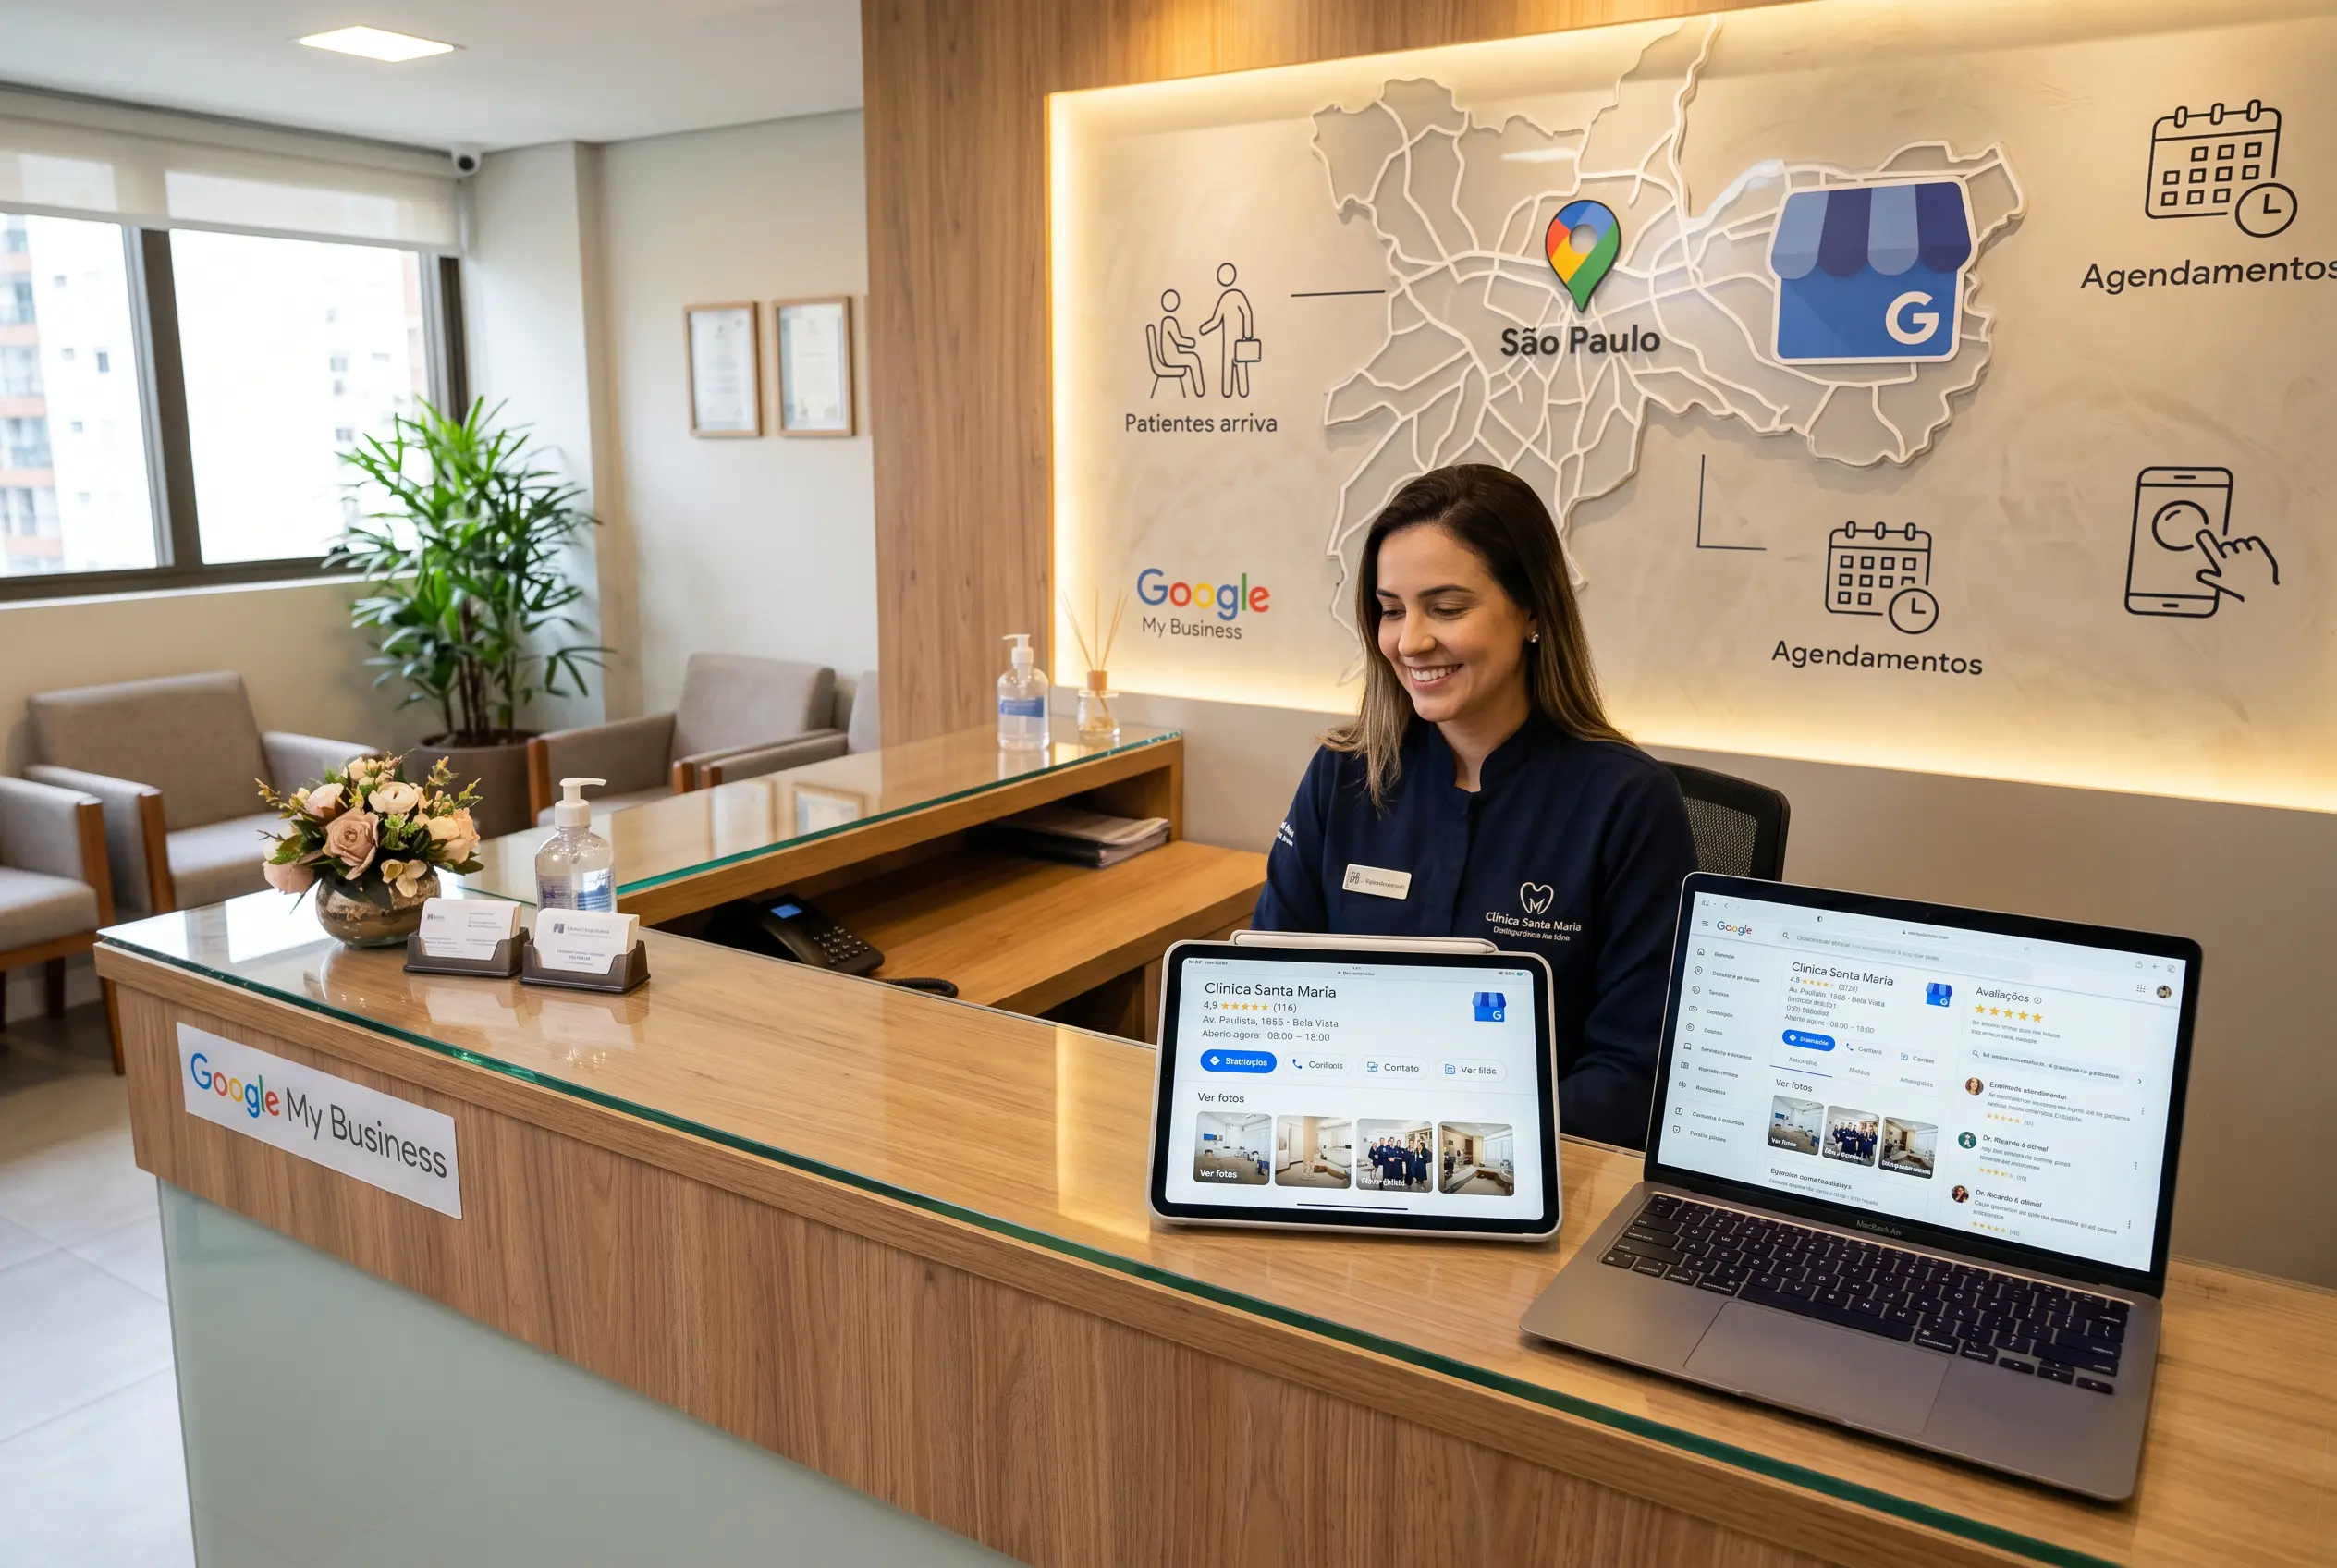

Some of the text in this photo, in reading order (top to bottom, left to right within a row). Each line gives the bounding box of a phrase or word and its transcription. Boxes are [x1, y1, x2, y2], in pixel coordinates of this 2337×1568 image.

[2080, 257, 2337, 295] Agendamentos
[1885, 291, 1939, 345] G
[1500, 325, 1660, 357] São Paulo
[1125, 413, 1278, 433] Patientes arriva
[1137, 568, 1270, 621] Google
[1143, 617, 1242, 640] My Business
[1772, 640, 1983, 676] Agendamentos
[1486, 912, 1582, 932] Clínica Santa Maria
[1717, 921, 1753, 937] Google
[1829, 968, 1861, 982] Santa
[1863, 974, 1894, 986] Maria
[1205, 982, 1337, 998] Clinica Santa Maria
[1273, 1003, 1297, 1014] (116)
[1203, 1016, 1216, 1024] Av.
[1219, 1016, 1258, 1026] Paulista,
[1292, 1018, 1313, 1028] Bela
[1315, 1019, 1339, 1028] Vista
[1267, 1032, 1293, 1040] 08:00
[1305, 1033, 1331, 1042] 18:00
[1384, 1063, 1419, 1072] Contato
[1461, 1066, 1477, 1074] Ver
[1776, 1079, 1813, 1093] Ver fotos
[1198, 1093, 1244, 1104] Ver fotos
[190, 1052, 447, 1179] Google My Business
[1200, 1169, 1214, 1178] Ver
